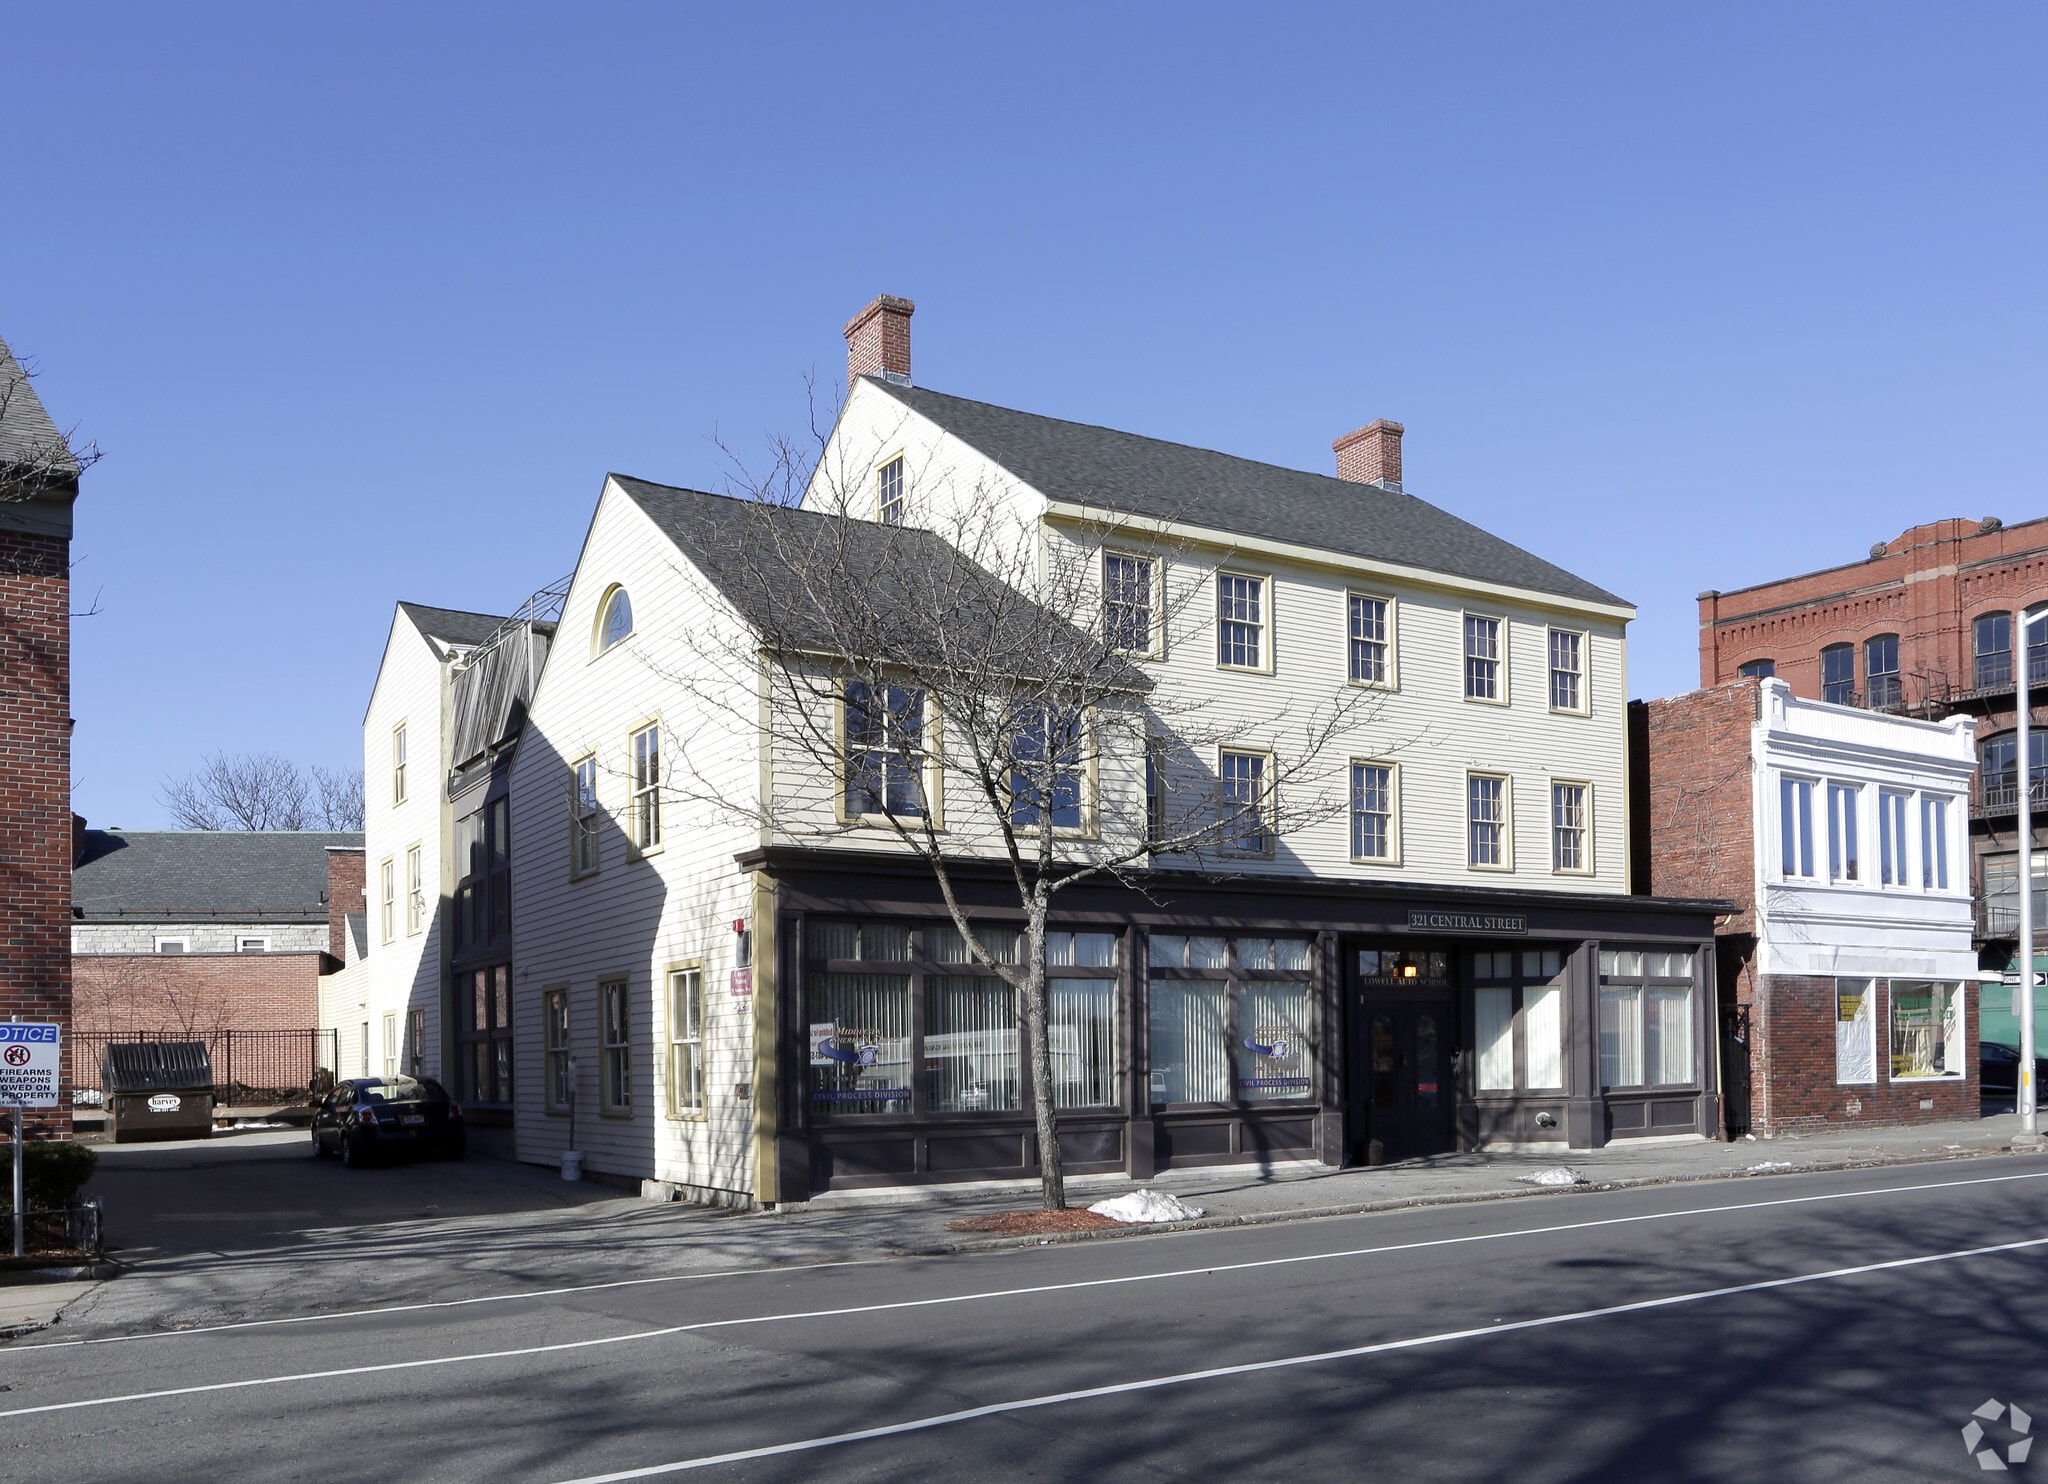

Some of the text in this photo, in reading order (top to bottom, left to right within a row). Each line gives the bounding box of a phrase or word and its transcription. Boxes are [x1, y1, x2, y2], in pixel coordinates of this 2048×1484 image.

[1411, 914, 1524, 930] 321 CENTRAL STREET
[1364, 977, 1447, 986] LOWELL AUTO SCHOOL
[0, 1027, 55, 1041] OTICE
[0, 1068, 52, 1076] FIREARMS
[813, 1090, 910, 1100] CIVIL PROCESS DIVISION
[152, 1097, 177, 1107] harvey
